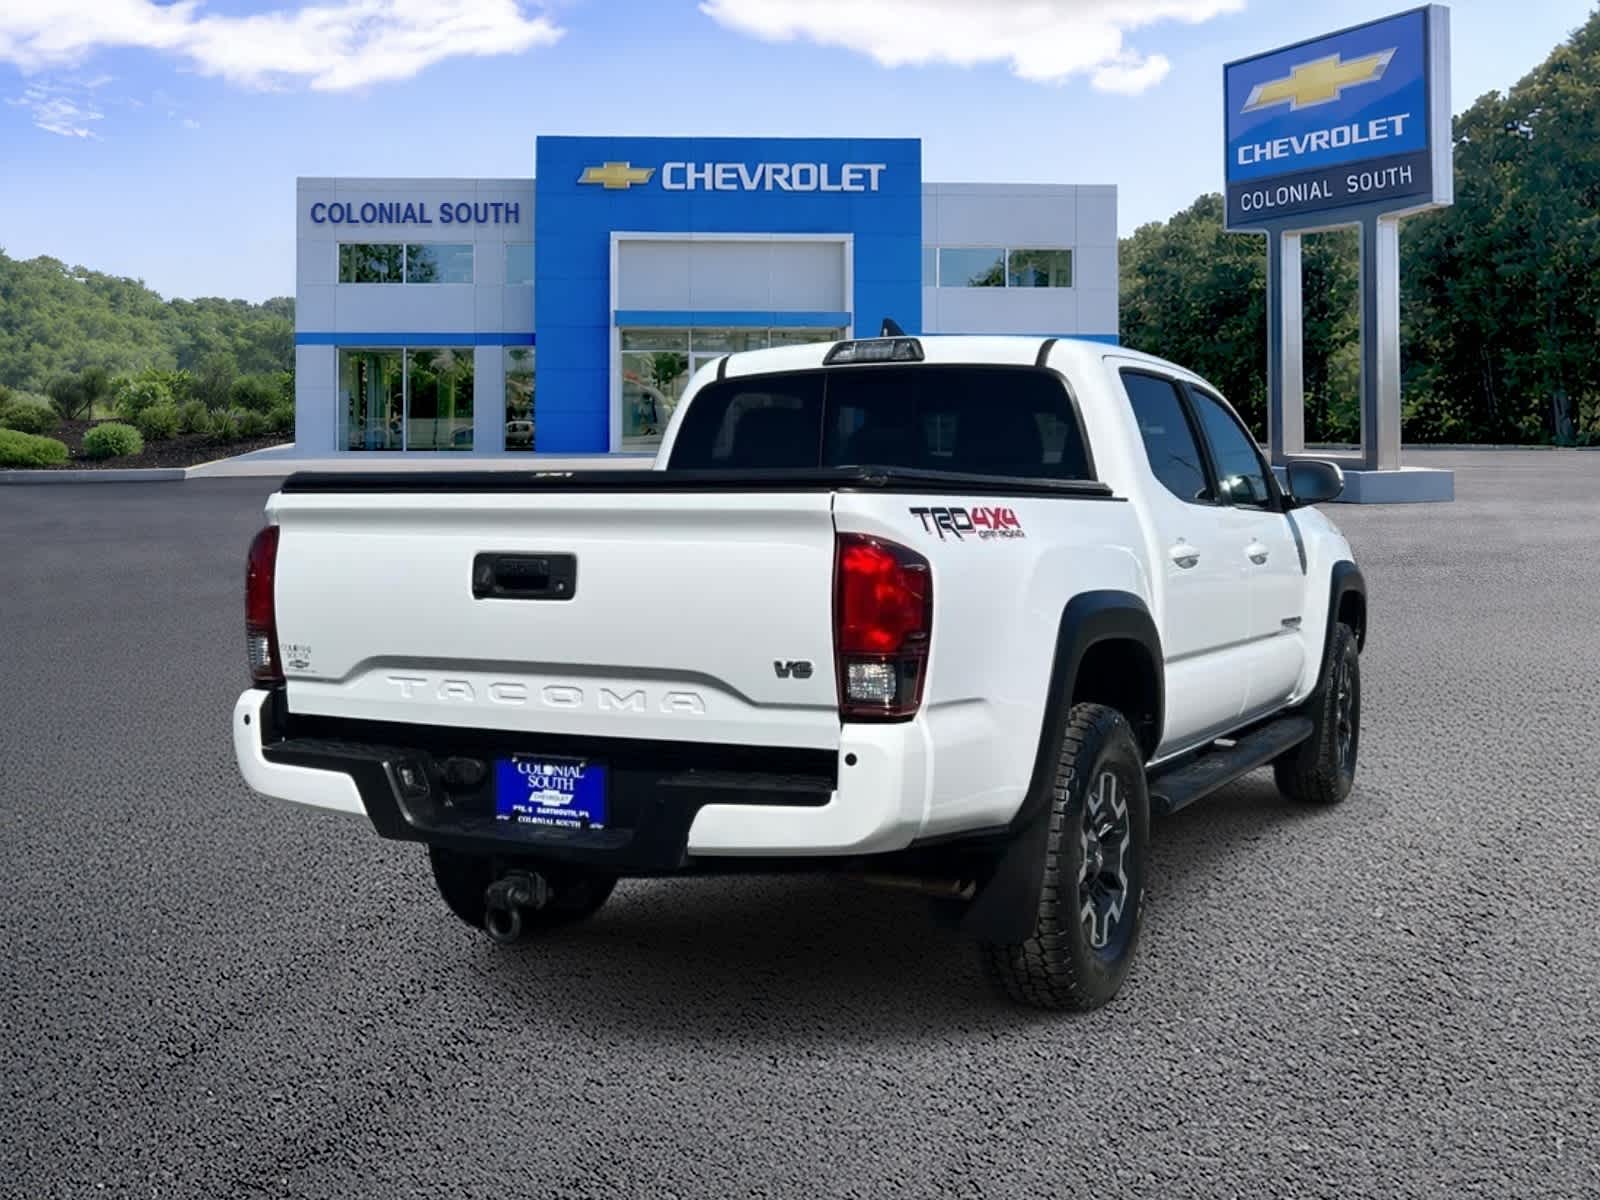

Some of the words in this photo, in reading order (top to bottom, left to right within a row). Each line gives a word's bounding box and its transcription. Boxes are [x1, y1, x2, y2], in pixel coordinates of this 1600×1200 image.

[1237, 113, 1410, 165] CHEVROLET
[661, 162, 887, 193] CHEVROLET
[1240, 180, 1333, 211] COLONIAL
[1346, 165, 1413, 193] SOUTH
[310, 203, 433, 225] COLONIAL
[440, 202, 520, 224] SOUTH
[773, 660, 813, 679] V6
[388, 676, 705, 714] TACOMA
[517, 762, 585, 778] COLONIAL
[528, 775, 574, 791] SOUTH
